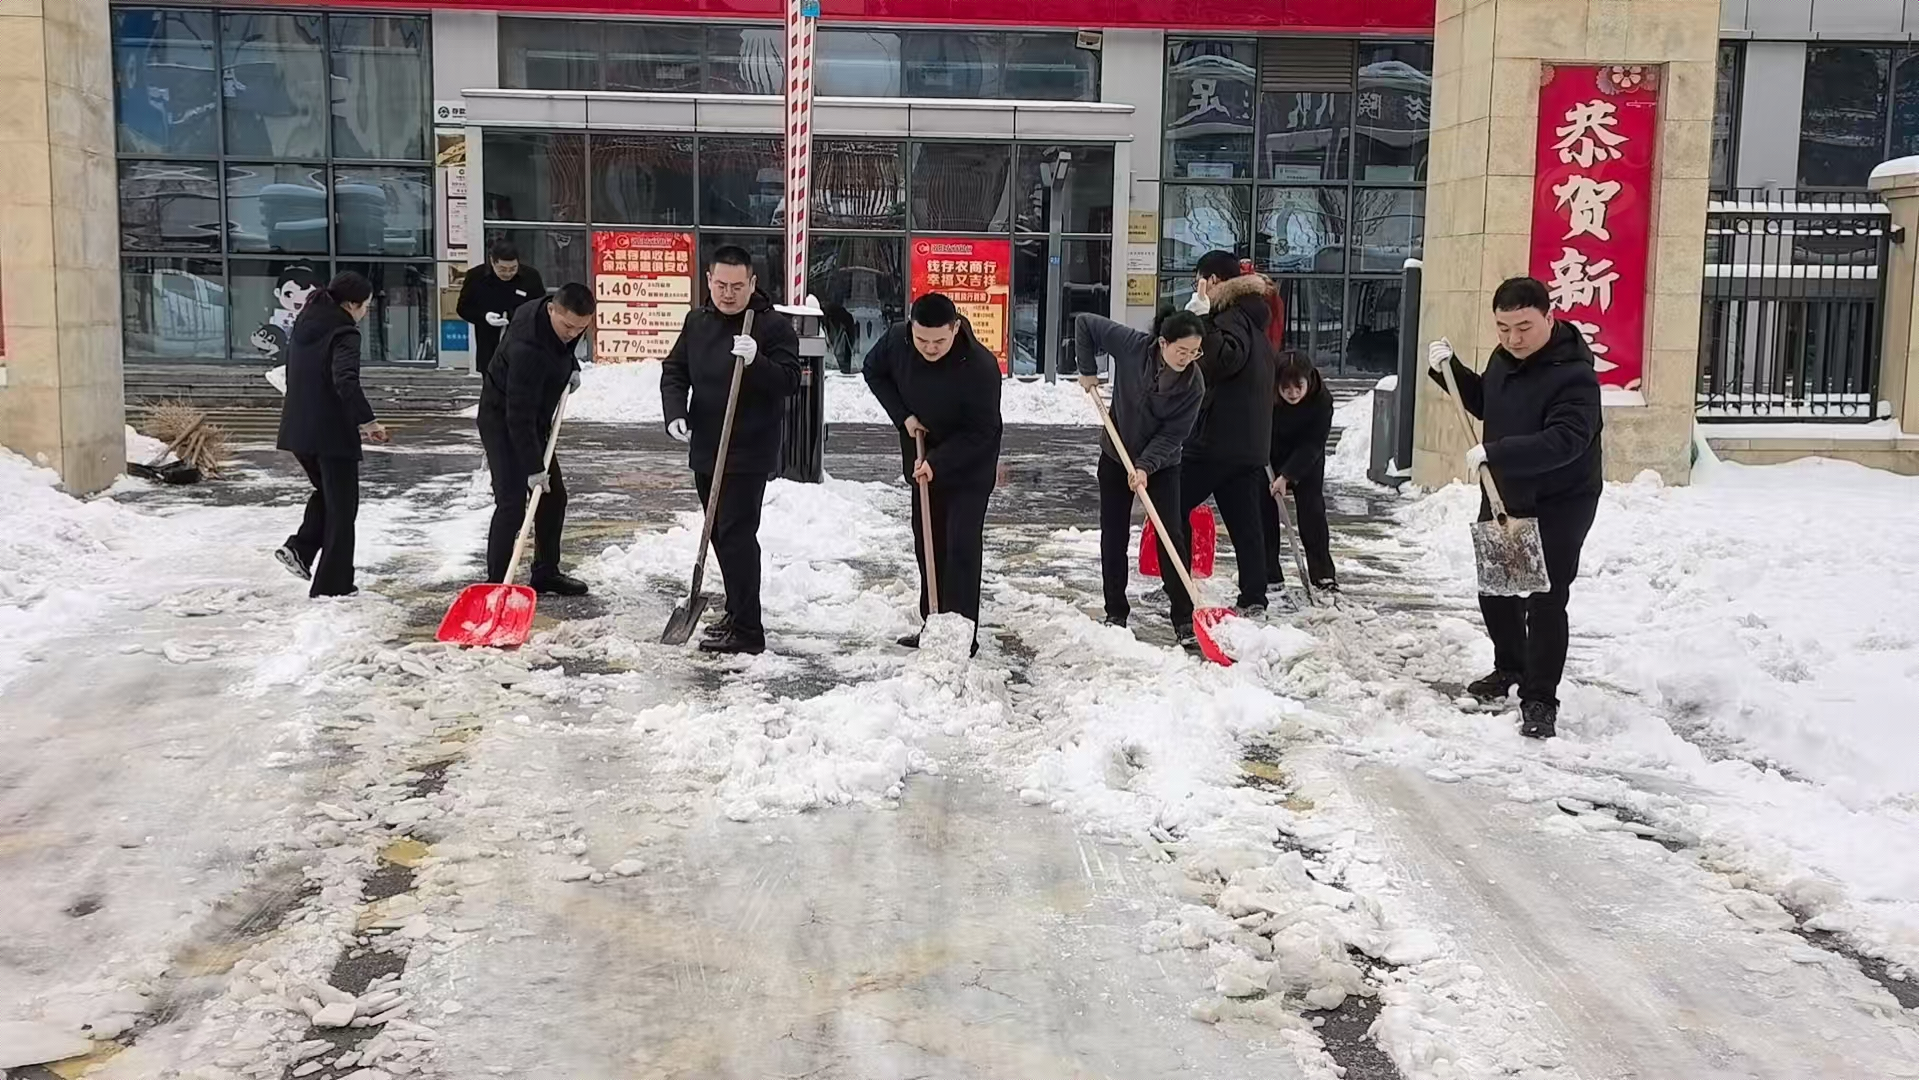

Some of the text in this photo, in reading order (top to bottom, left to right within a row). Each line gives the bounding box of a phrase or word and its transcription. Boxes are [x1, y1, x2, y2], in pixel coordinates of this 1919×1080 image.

[927, 260, 996, 274] 钱存农商行
[927, 273, 996, 287] 幸福又吉祥
[598, 281, 646, 296] 1.40%
[598, 312, 647, 326] 1.45%
[599, 340, 645, 353] 1.77%
